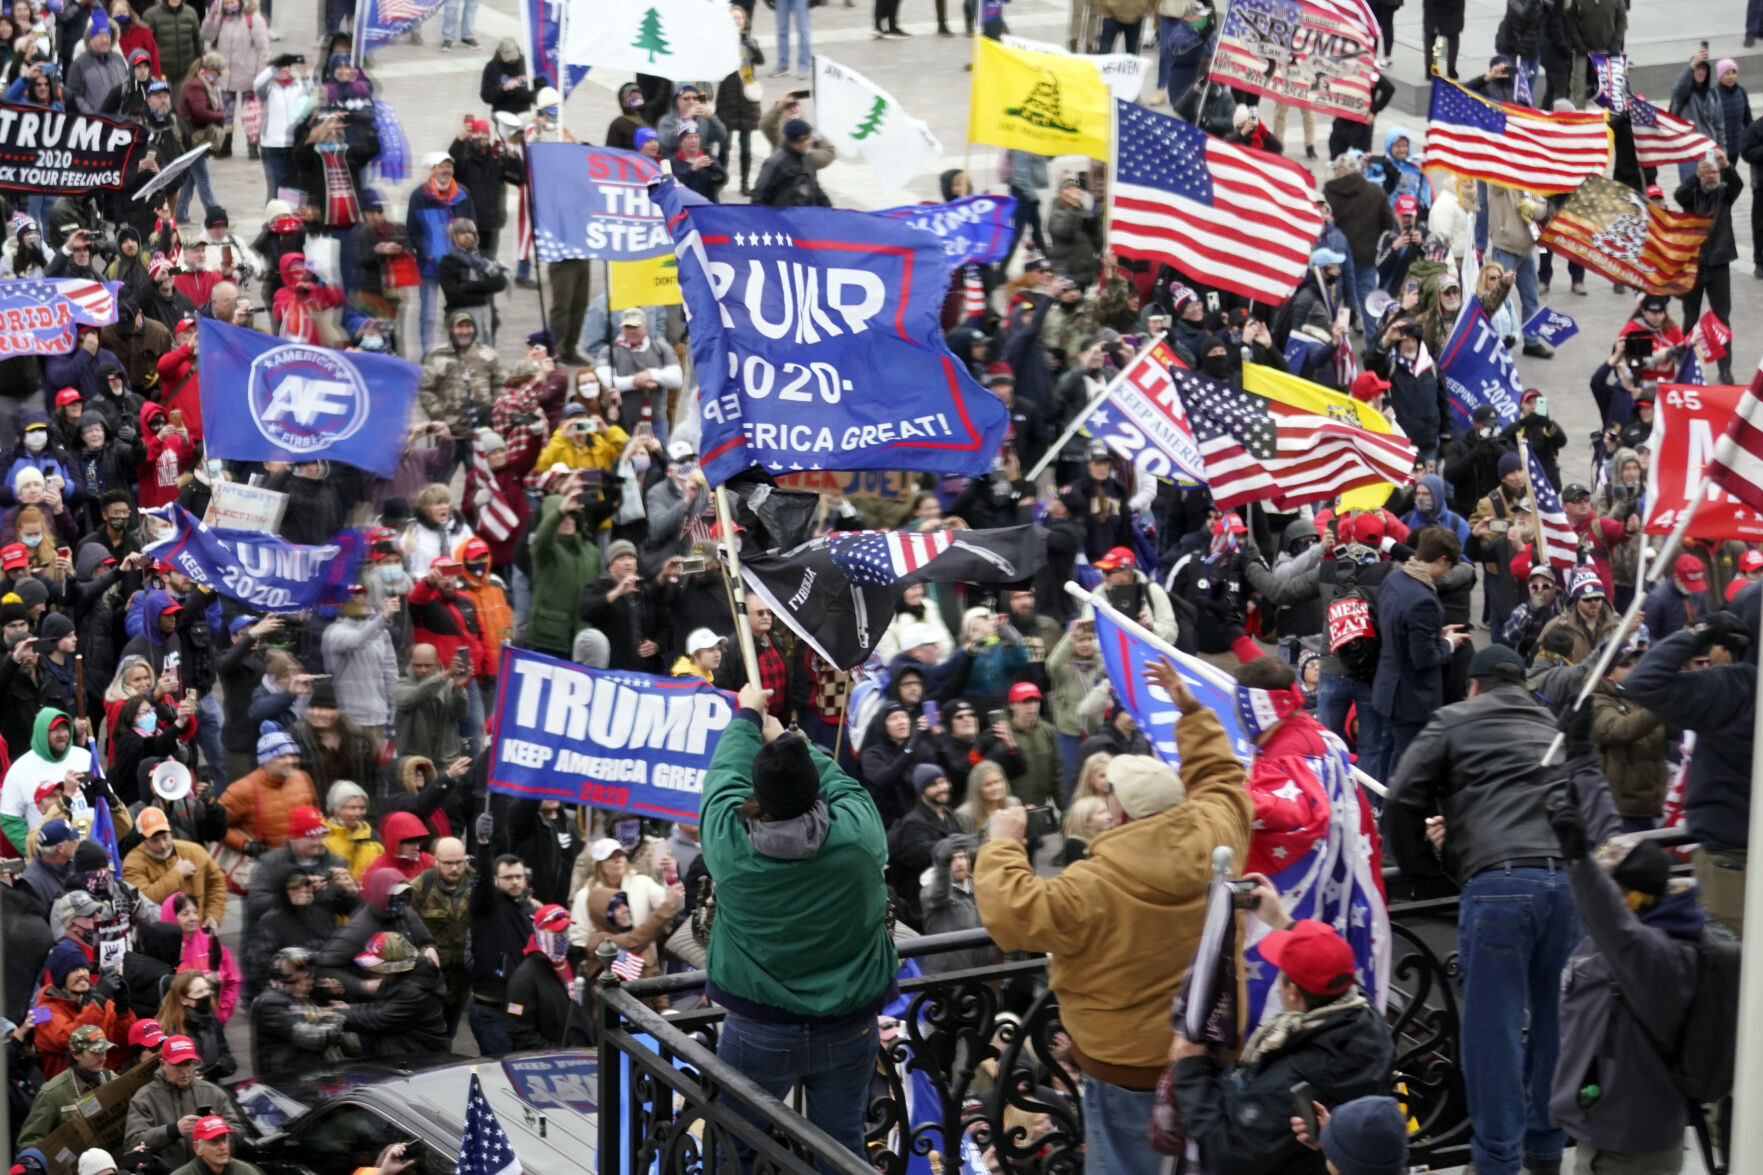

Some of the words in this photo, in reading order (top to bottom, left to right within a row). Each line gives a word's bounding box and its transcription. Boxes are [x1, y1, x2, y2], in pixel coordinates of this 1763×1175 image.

[0, 109, 132, 152] TRUMP
[35, 149, 73, 169] 2020
[20, 167, 59, 186] YOUR
[60, 170, 121, 188] FEELINGS
[272, 349, 338, 371] AMERICA
[260, 374, 357, 426] AF
[1115, 381, 1154, 419] KEEP
[1667, 390, 1702, 411] 45
[841, 413, 953, 451] GREAT!
[178, 550, 208, 584] KEEP
[514, 658, 733, 755] TRUMP
[501, 738, 553, 769] KEEP
[553, 749, 648, 784] AMERICA
[578, 781, 630, 807] 2020
